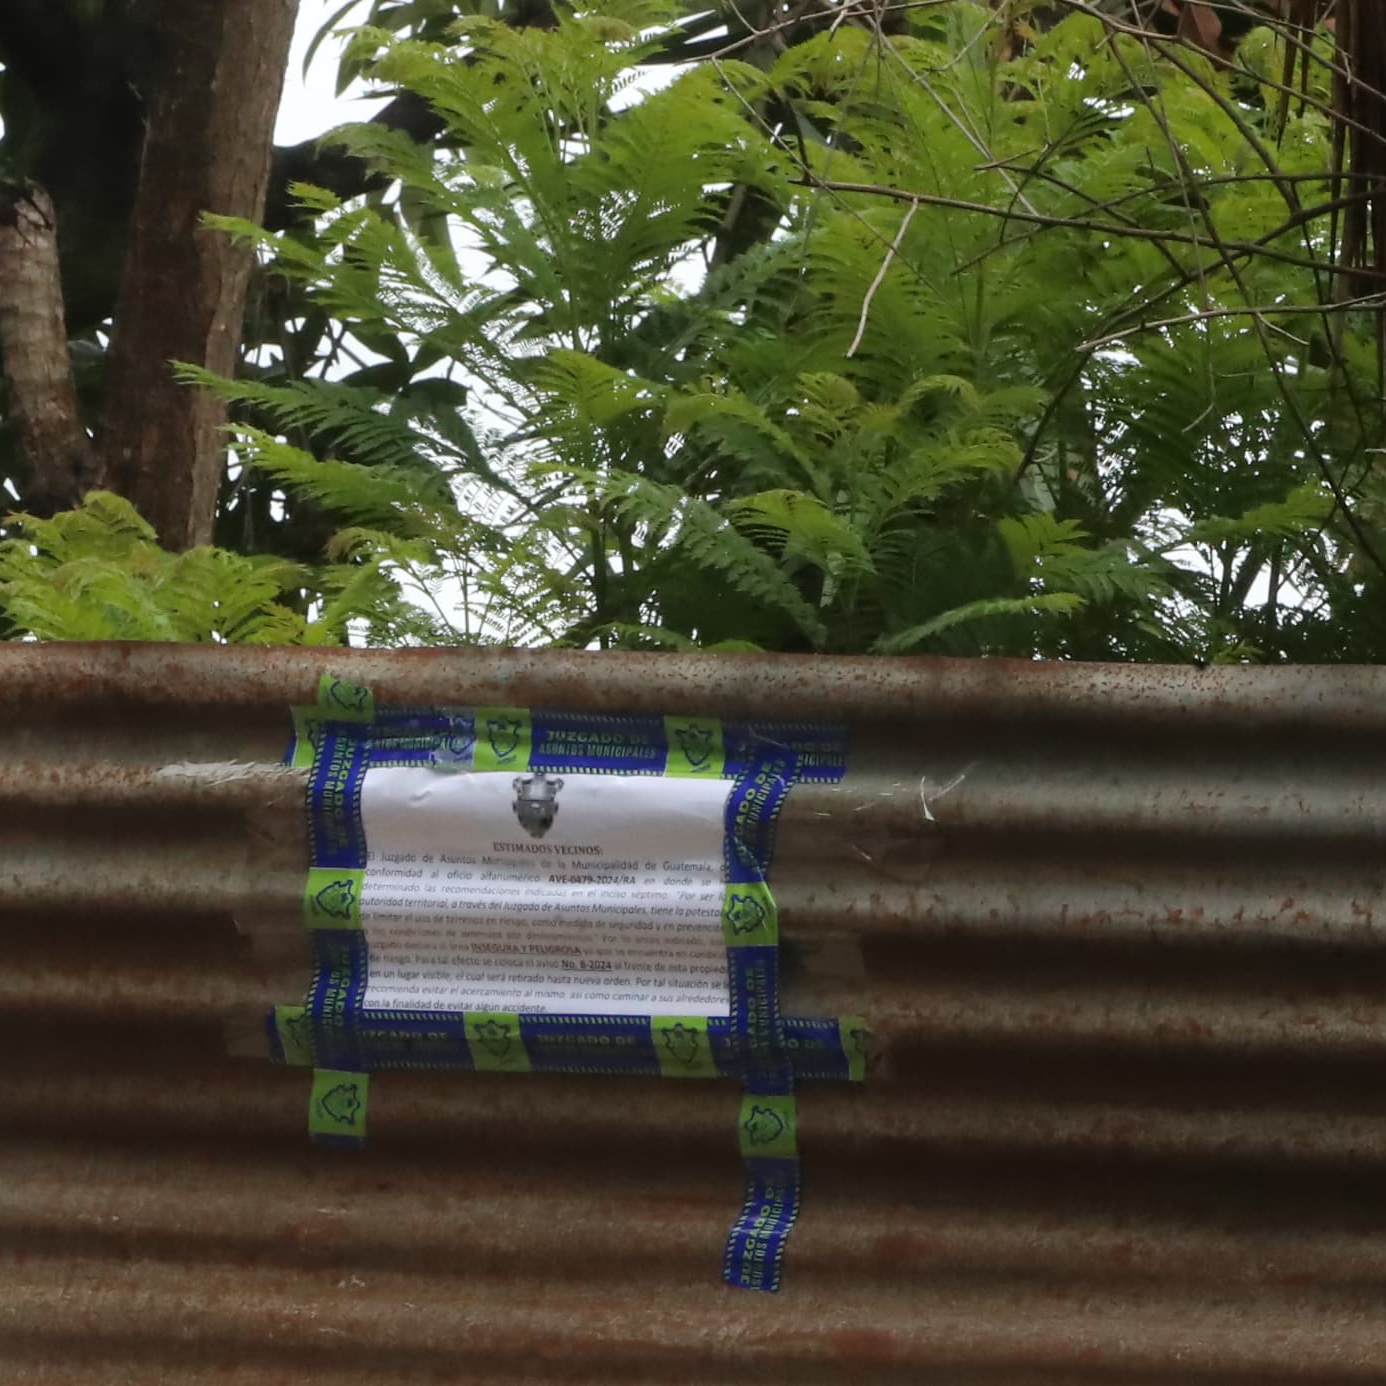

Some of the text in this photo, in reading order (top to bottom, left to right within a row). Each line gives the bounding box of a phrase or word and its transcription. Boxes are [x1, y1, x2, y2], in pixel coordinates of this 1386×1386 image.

[584, 744, 657, 761] MUNICIPALES
[493, 842, 552, 854] ESTIMADOS
[381, 853, 416, 864] Juzgado
[422, 854, 434, 862] de
[571, 861, 639, 872] Municipalidad
[645, 861, 657, 870] de
[365, 868, 423, 878] conformidad
[430, 870, 440, 879] al
[446, 871, 473, 880] oficio
[663, 877, 694, 886] donde
[362, 884, 421, 892] determinado
[442, 886, 521, 896] recomendaciones
[359, 897, 404, 907] autoridad
[488, 901, 502, 911] del
[503, 902, 541, 913] Juzgado
[541, 903, 554, 912] de
[554, 903, 591, 912] Asuntos
[650, 905, 675, 915] tiene
[451, 956, 482, 966] efecto
[370, 970, 382, 978] en
[383, 970, 396, 978] un
[397, 969, 420, 980] lugar
[455, 971, 465, 980] el
[465, 971, 485, 980] cual
[508, 973, 545, 983] retirado
[547, 974, 572, 984] hasta
[573, 976, 602, 985] nueva
[636, 976, 652, 987] Por
[653, 978, 666, 987] tal
[667, 979, 710, 989] situación
[710, 982, 722, 990] se
[366, 985, 420, 994] recomienda
[421, 986, 448, 995] evitar
[449, 986, 460, 995] el
[460, 987, 522, 998] acercamiento
[583, 992, 612, 1000] como
[612, 993, 649, 1002] caminar
[364, 1000, 380, 1008] con
[381, 999, 391, 1008] la
[392, 997, 433, 1009] finalidad
[433, 999, 446, 1009] de
[447, 1000, 474, 1010] evitar
